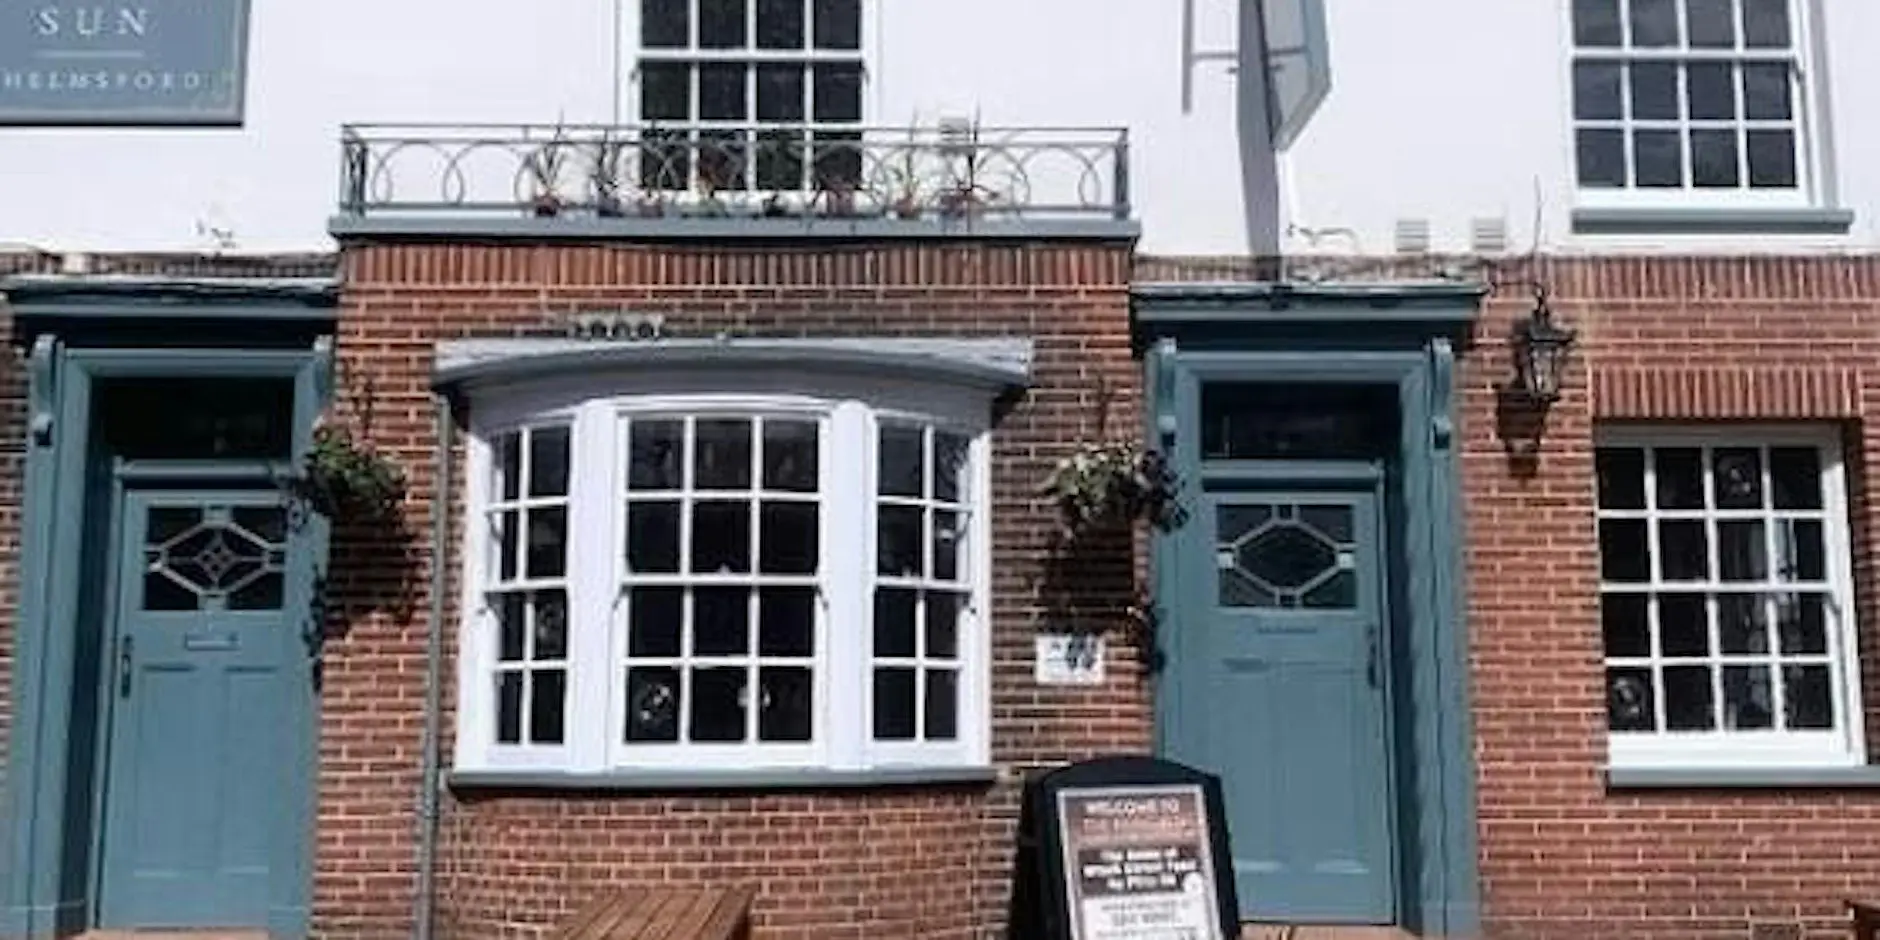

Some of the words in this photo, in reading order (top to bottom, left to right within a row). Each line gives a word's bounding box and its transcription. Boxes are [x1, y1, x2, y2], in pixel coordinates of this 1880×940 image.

[37, 7, 148, 36] SUN
[1085, 799, 1156, 816] WELCOME
[1160, 797, 1180, 814] TO
